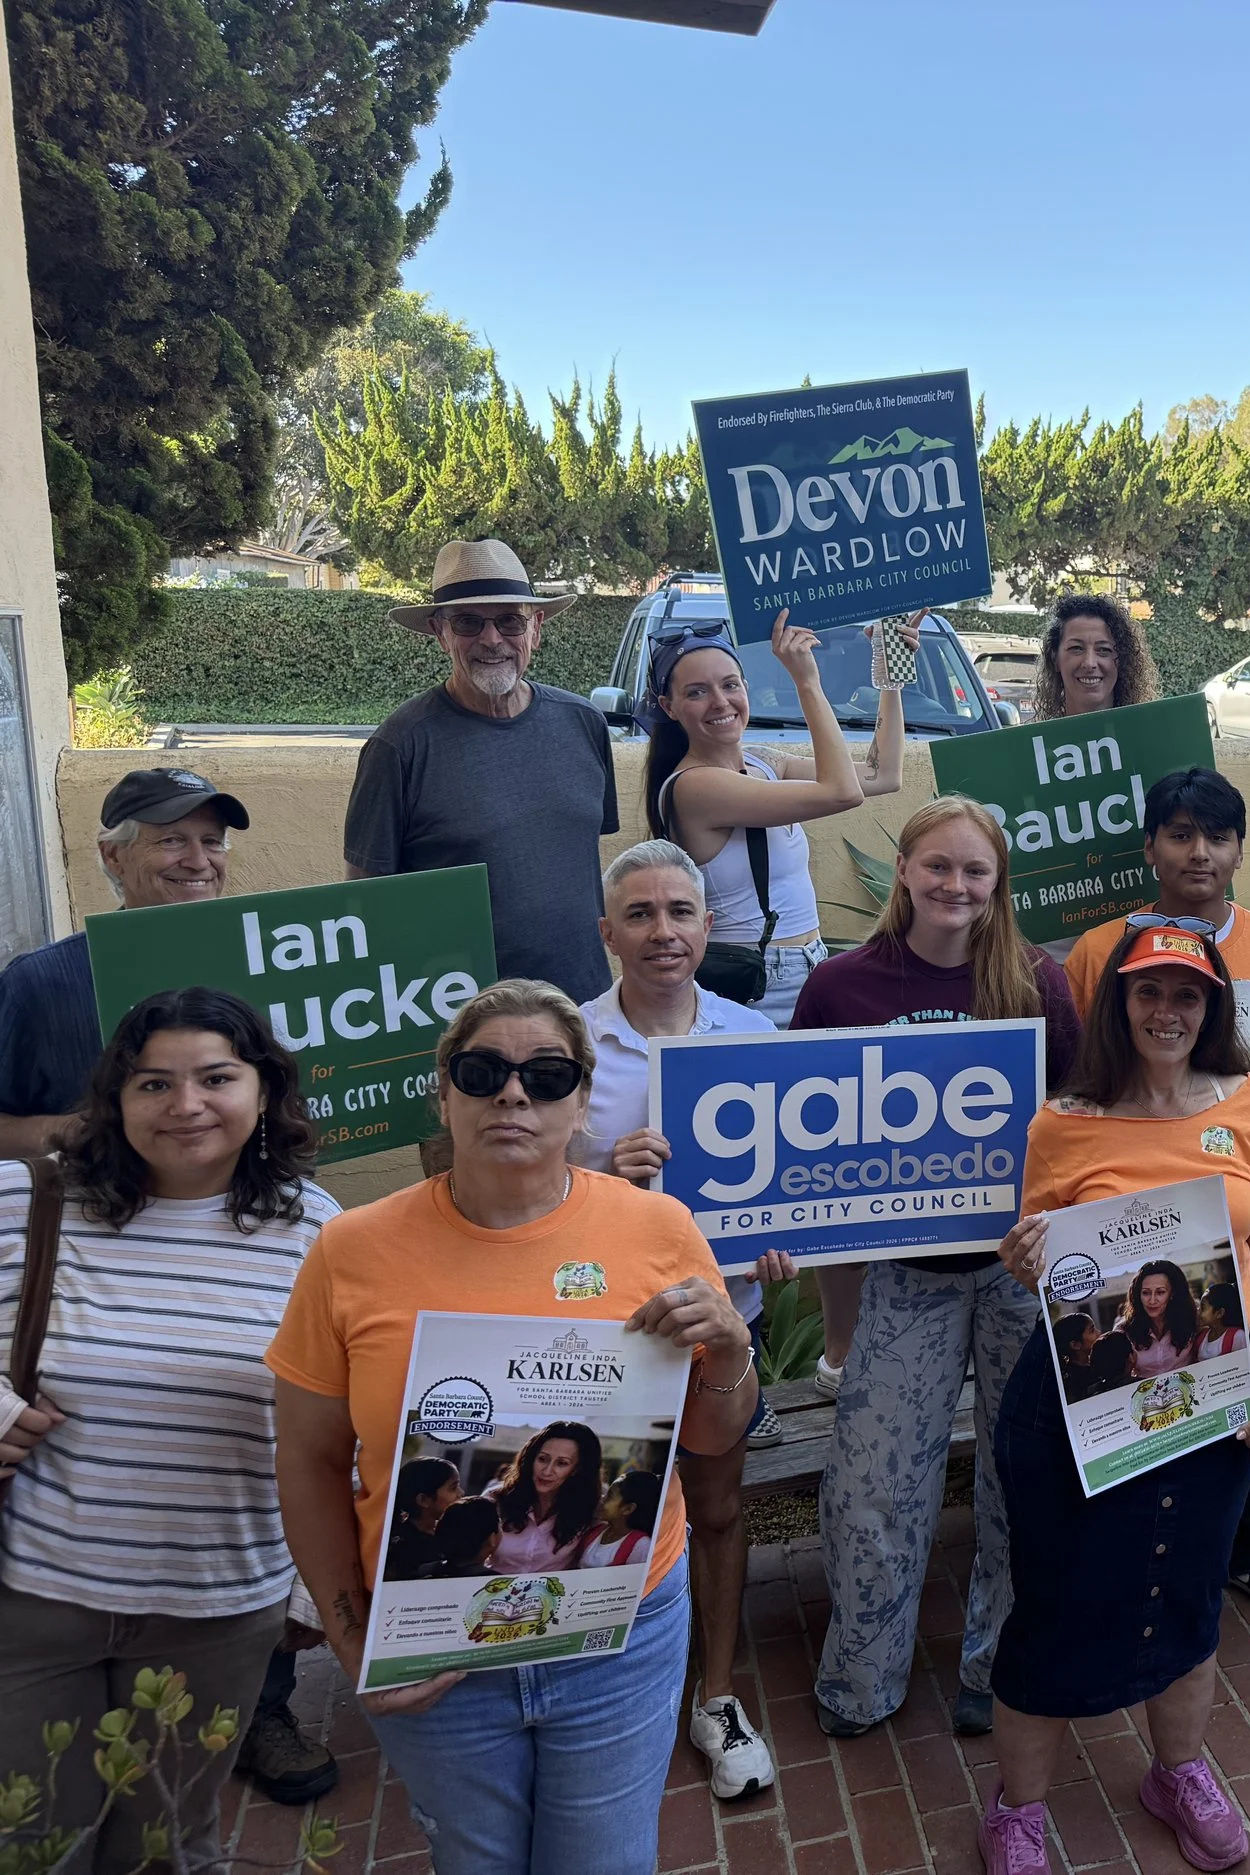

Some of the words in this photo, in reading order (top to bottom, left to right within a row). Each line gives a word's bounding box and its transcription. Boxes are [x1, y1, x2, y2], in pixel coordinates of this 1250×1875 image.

[718, 413, 755, 428] Endorsed
[757, 413, 767, 426] By
[770, 406, 816, 423] Firefighters,
[817, 404, 830, 415] The
[832, 401, 854, 414] Sierra
[855, 399, 874, 411] Club,
[876, 398, 881, 408] &
[882, 396, 895, 407] The
[897, 391, 935, 406] Democratic
[937, 389, 954, 402] Party
[728, 456, 965, 543] Devon
[745, 519, 966, 586] WARDLOW
[754, 590, 801, 611] SANTA
[808, 574, 873, 601] BARBARA
[880, 571, 908, 587] CITY
[915, 559, 971, 580] COUNCIL
[1032, 735, 1122, 785] Ian
[1087, 853, 1103, 868] for
[1039, 876, 1103, 906] BARBARA
[1111, 867, 1144, 890] CITY
[1062, 898, 1144, 924] IanForSB.com
[242, 911, 369, 975] Ian
[912, 1009, 953, 1022] THAN
[311, 1064, 335, 1084] for
[345, 1081, 390, 1111] CITY
[692, 1045, 1013, 1202] gabe
[780, 1142, 1014, 1195] escobedo
[721, 1213, 772, 1230] FOR
[791, 1202, 851, 1222] CITY
[870, 1191, 992, 1213] COUNCIL
[1105, 1213, 1151, 1228] JACQUELINE
[1099, 1212, 1181, 1245] KARLSEN
[1052, 1266, 1095, 1282] DEMOCRATIC
[1054, 1277, 1077, 1288] PARTY
[1051, 1280, 1104, 1300] ENDORSEMENT
[520, 1352, 587, 1361] JACQUELINE
[507, 1359, 625, 1383] KARLSEN
[424, 1409, 459, 1417] PARTY
[425, 1401, 488, 1409] DEMOCRATIC
[414, 1422, 492, 1433] ENDORSEMENT
